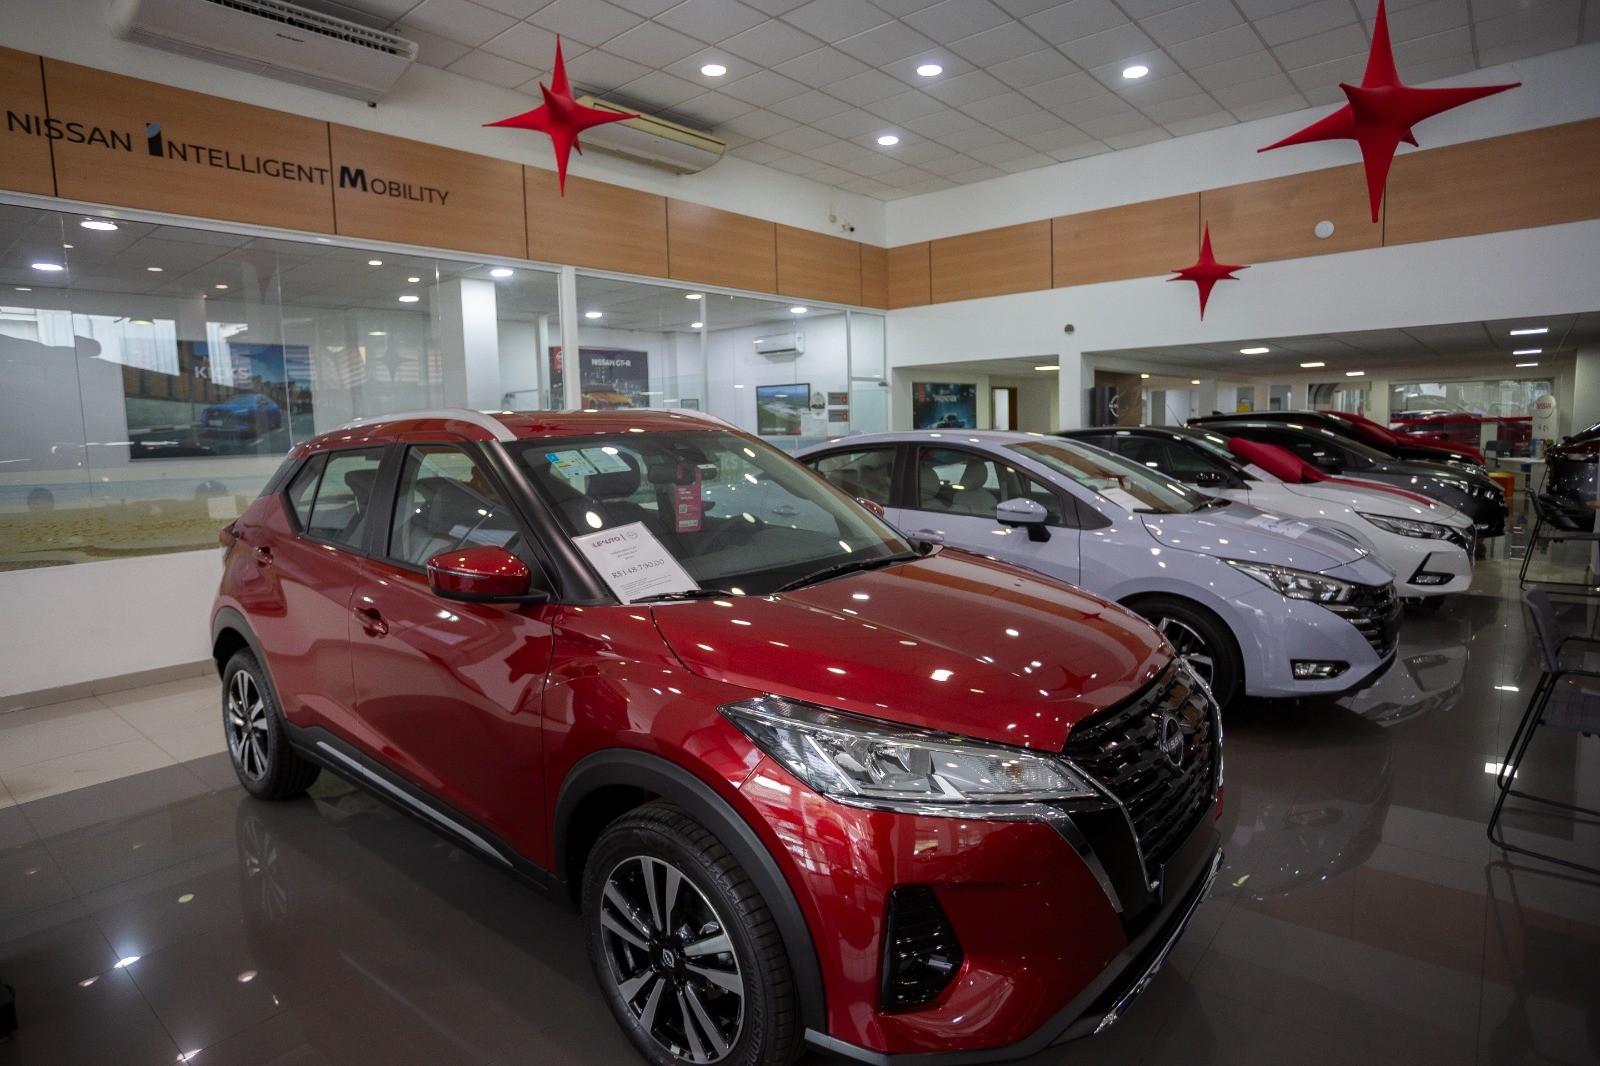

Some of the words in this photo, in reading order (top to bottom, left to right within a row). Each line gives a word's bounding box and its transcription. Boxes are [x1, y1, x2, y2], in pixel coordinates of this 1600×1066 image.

[7, 110, 132, 152] NISSAN
[146, 123, 329, 185] INTELLIGENT
[339, 165, 449, 206] MOBILITY
[591, 358, 615, 366] NISSAN
